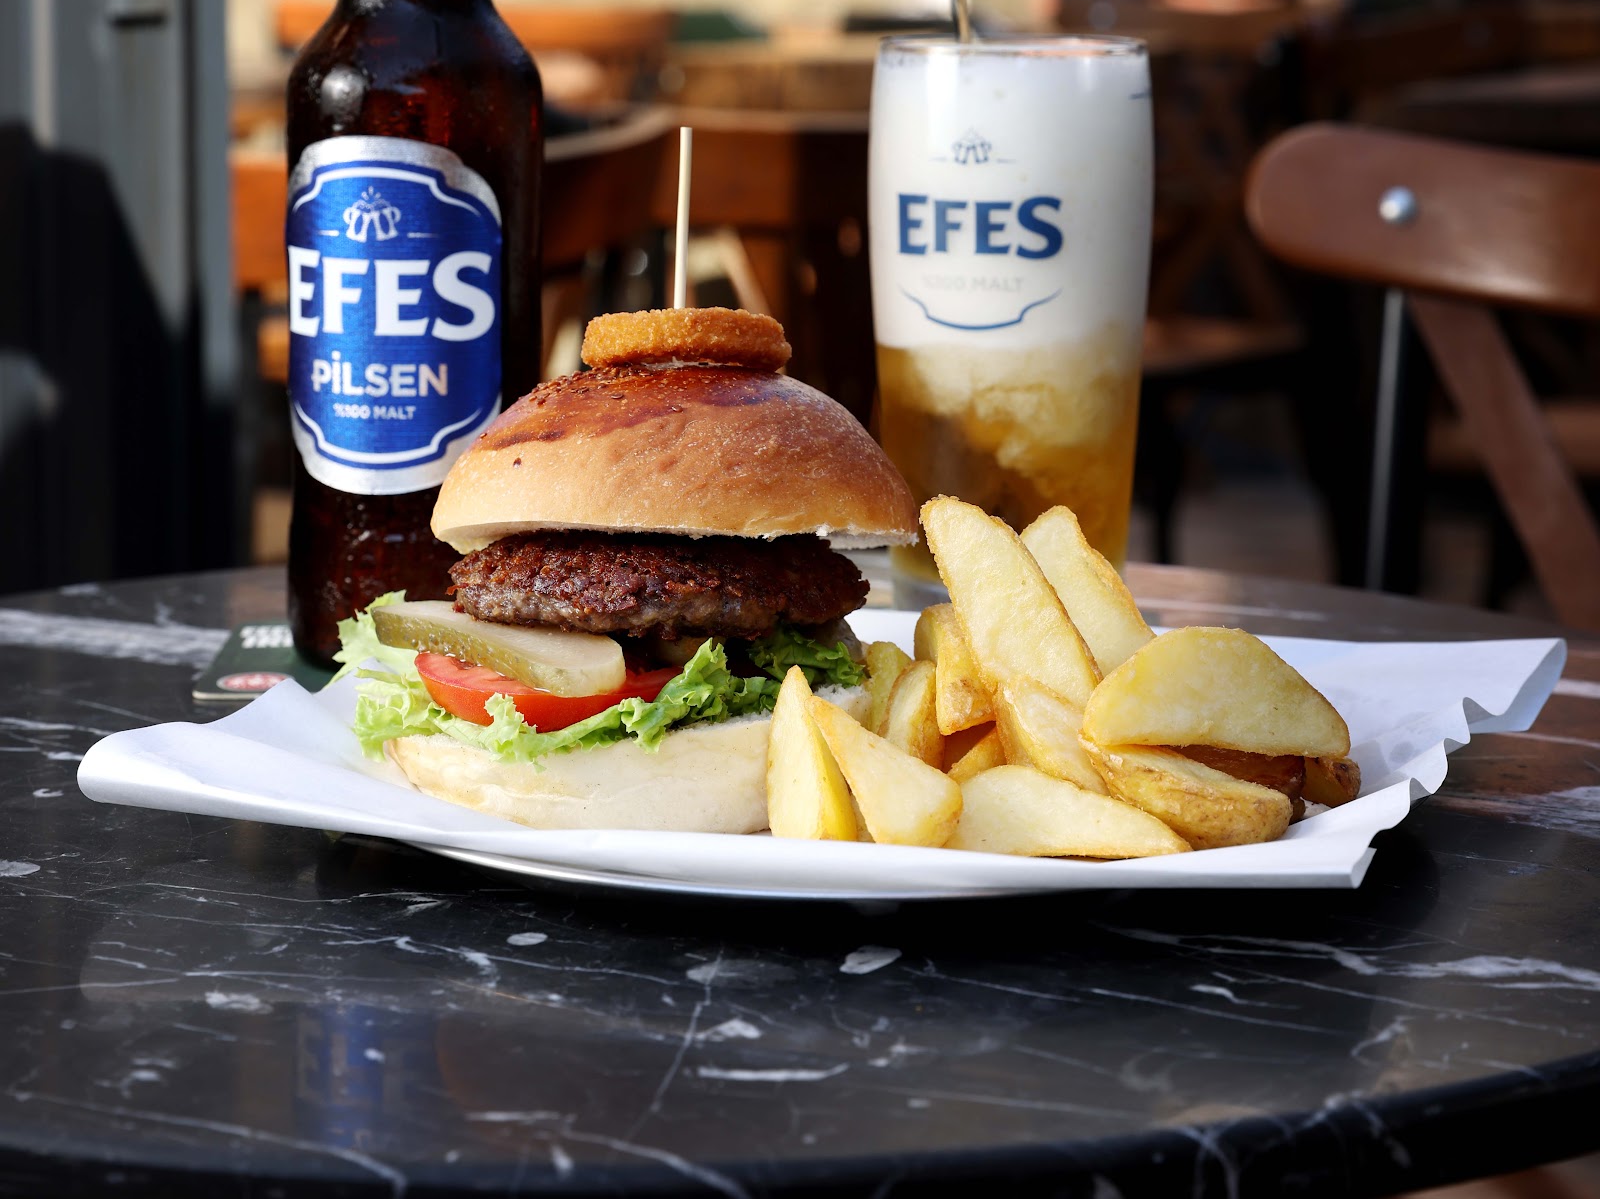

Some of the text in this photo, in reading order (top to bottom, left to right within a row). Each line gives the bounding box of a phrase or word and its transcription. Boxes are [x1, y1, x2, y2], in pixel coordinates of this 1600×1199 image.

[898, 193, 1064, 260] EFES
[288, 246, 496, 342] EFES
[311, 350, 448, 397] PİLSEN
[373, 405, 416, 420] MALT
